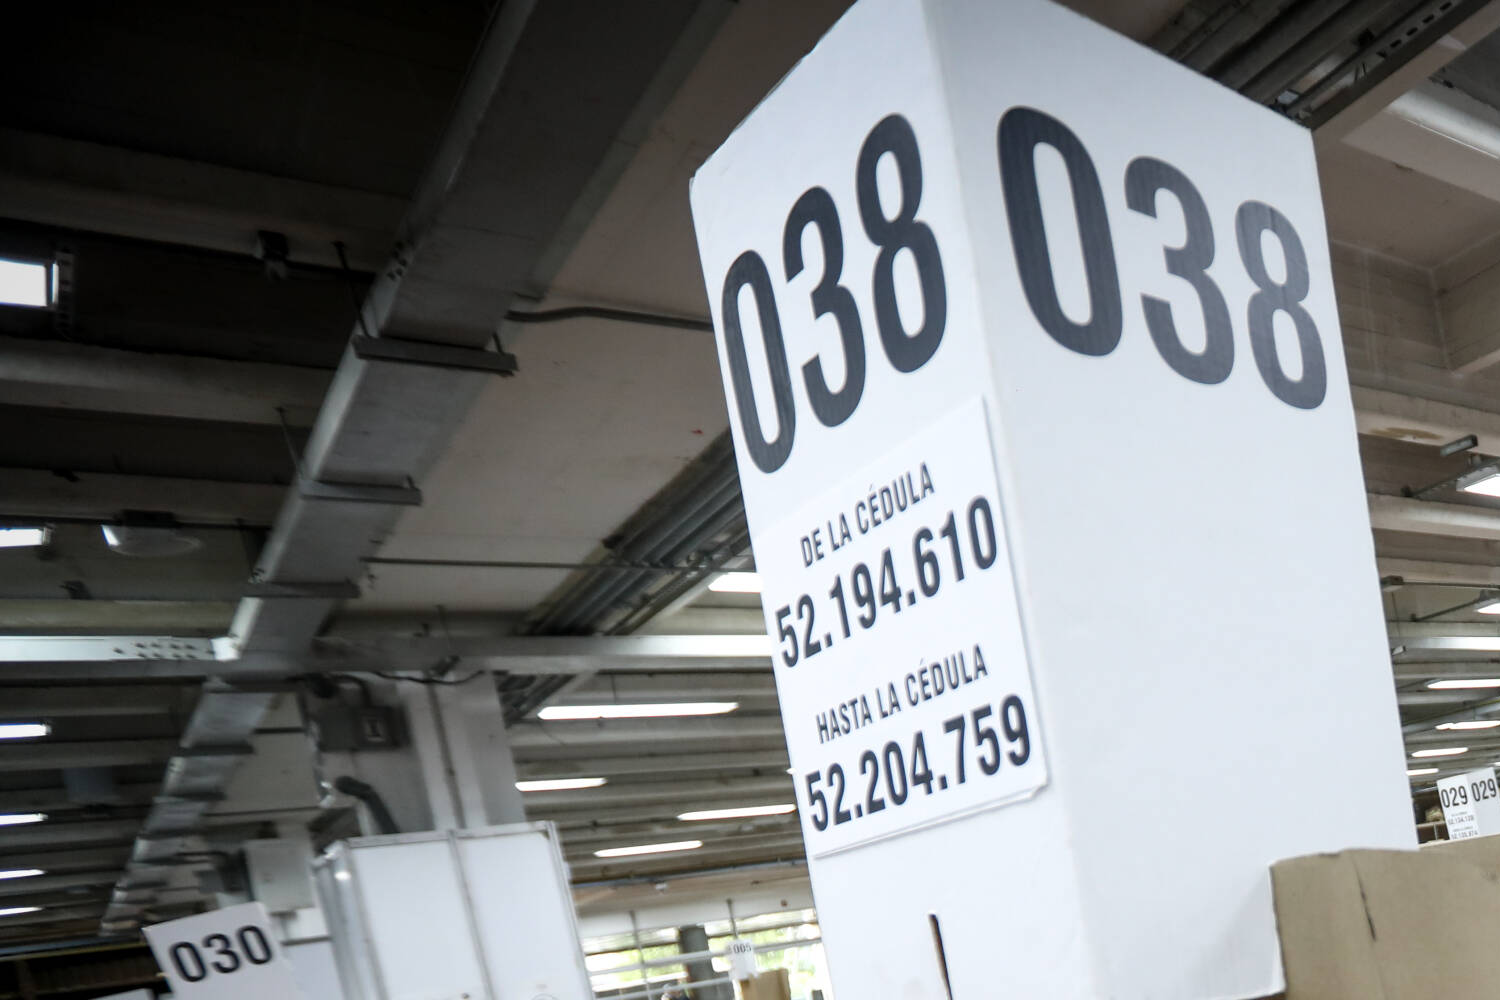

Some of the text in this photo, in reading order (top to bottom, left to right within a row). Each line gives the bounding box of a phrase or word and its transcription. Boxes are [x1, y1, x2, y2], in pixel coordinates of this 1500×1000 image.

[722, 112, 948, 475] 038
[996, 105, 1328, 410] 038
[800, 461, 935, 568] DE LA CÉDULA
[775, 495, 998, 669] 52.194.610
[816, 643, 988, 745] HASTA LA CÉDULA
[805, 694, 1031, 832] 52.204.759
[1441, 785, 1469, 808] 029
[1471, 778, 1497, 802] 029
[169, 925, 273, 983] 030
